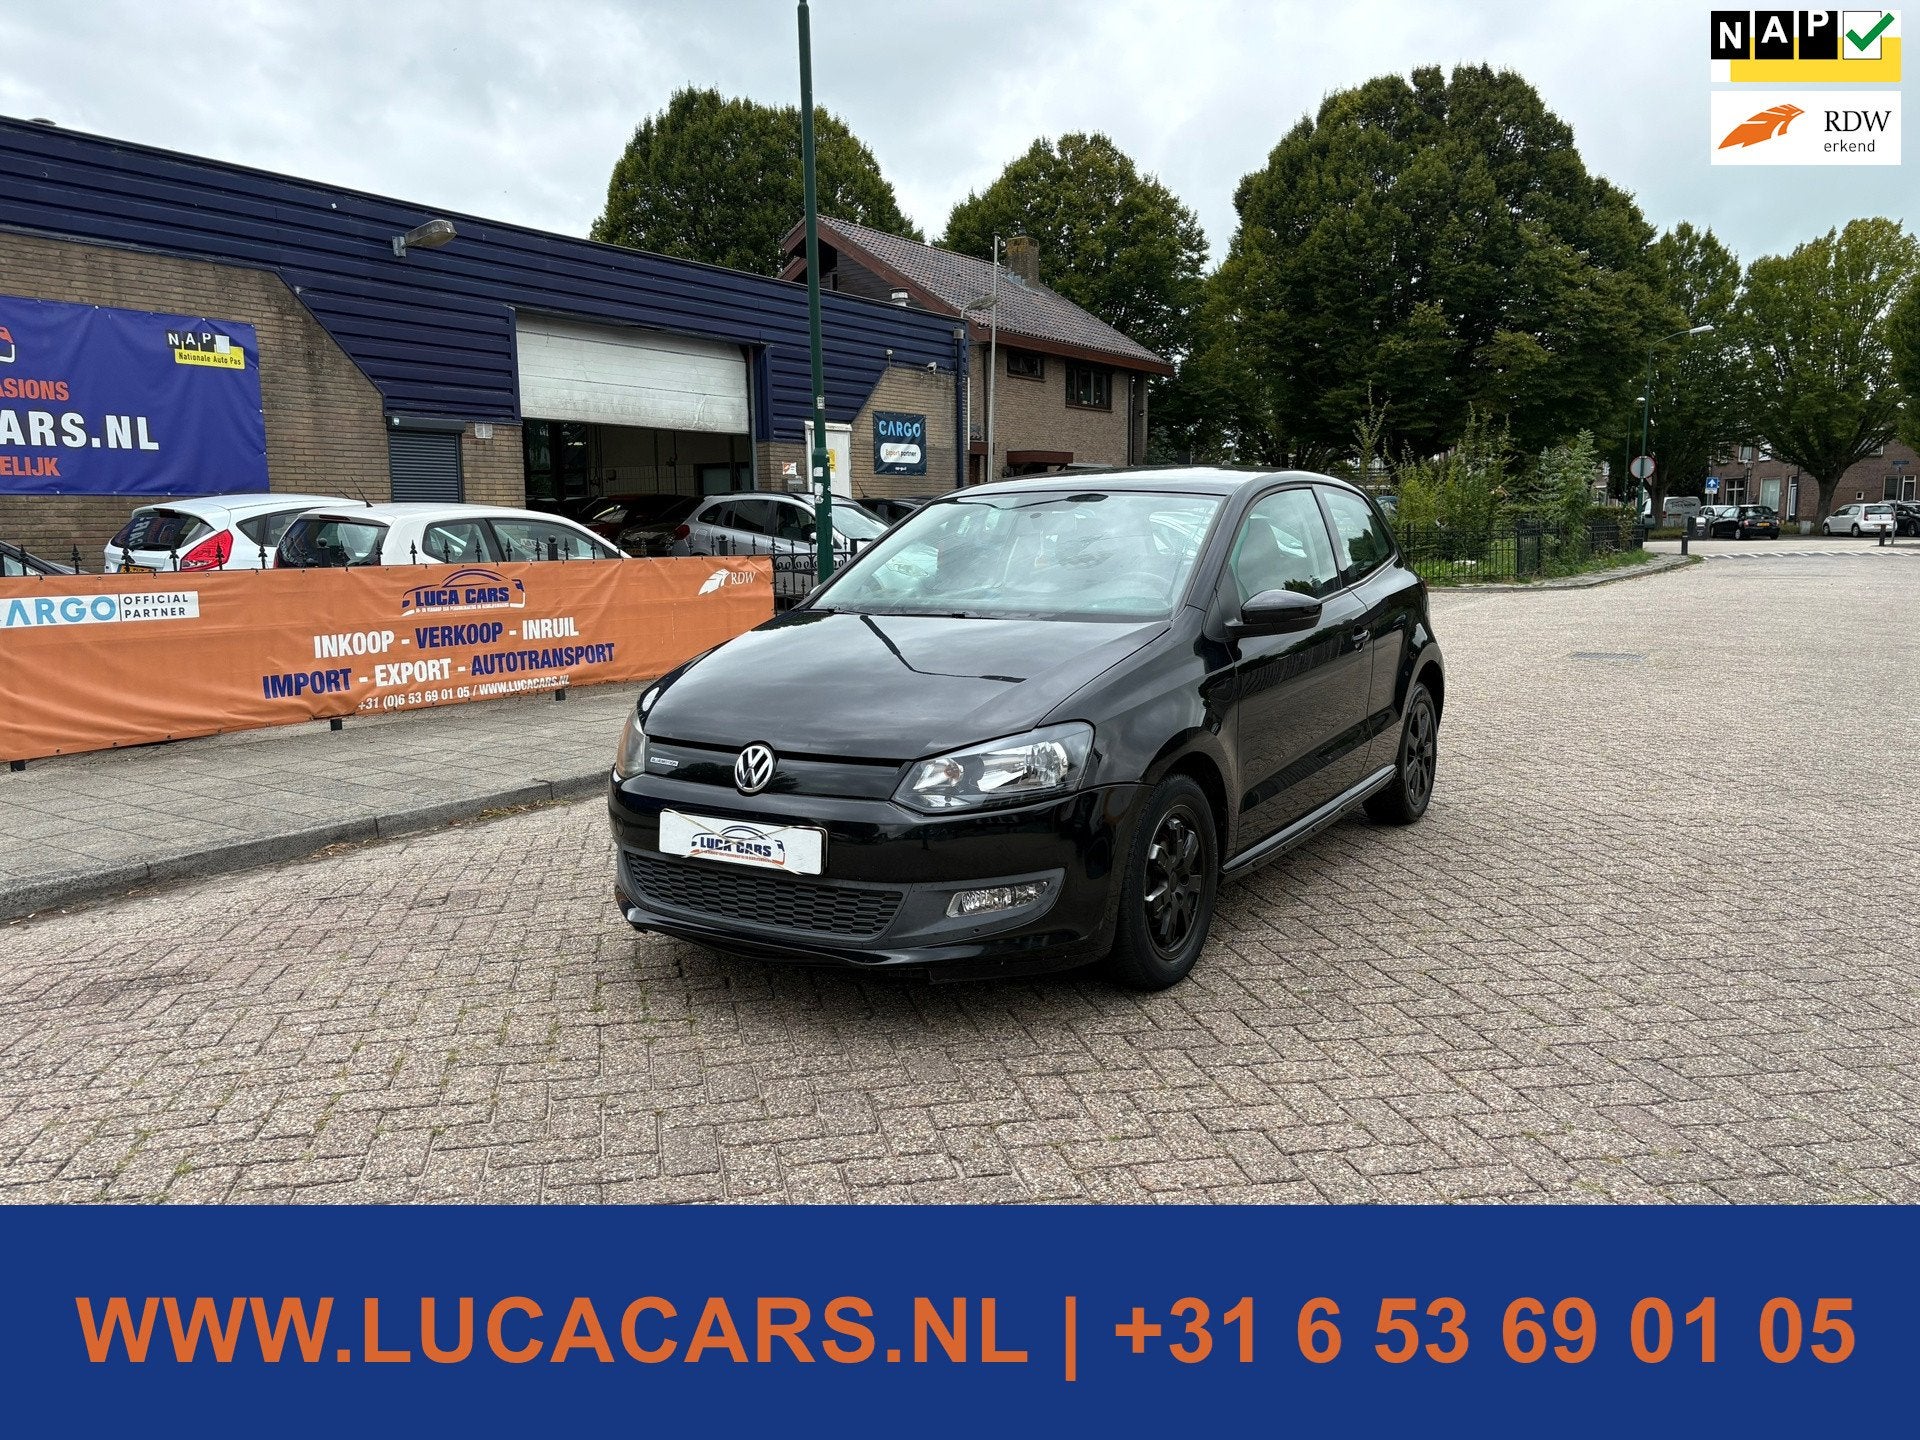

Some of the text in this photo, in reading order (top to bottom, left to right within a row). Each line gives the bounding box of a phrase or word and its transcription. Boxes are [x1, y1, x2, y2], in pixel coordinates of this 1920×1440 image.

[167, 332, 212, 346] NAP
[178, 352, 242, 366] Nationale Auto Pas
[0, 409, 160, 451] ARS.NL
[878, 420, 921, 438] CARGO
[0, 455, 62, 477] ELIJK
[731, 571, 756, 585] RDW
[123, 593, 189, 606] OFFICIAL
[415, 586, 510, 607] LUCA CARS
[124, 606, 186, 619] PARTNER
[313, 630, 395, 659] INKOOP
[415, 622, 504, 649] VERKOOP
[522, 616, 580, 640] INRUIL
[262, 667, 352, 700] IMPORT
[374, 657, 452, 688] EXPORT
[471, 642, 615, 677] AUTOTRANSPORT
[358, 697, 379, 711] +31
[383, 694, 405, 710] (0)6
[408, 691, 422, 704] 53
[424, 689, 439, 703] 69
[441, 687, 453, 701] 01
[457, 685, 470, 698] 05
[479, 674, 570, 697] WWW.LUCACARS.NL
[700, 836, 732, 852] LUCA
[736, 842, 772, 857] CARS
